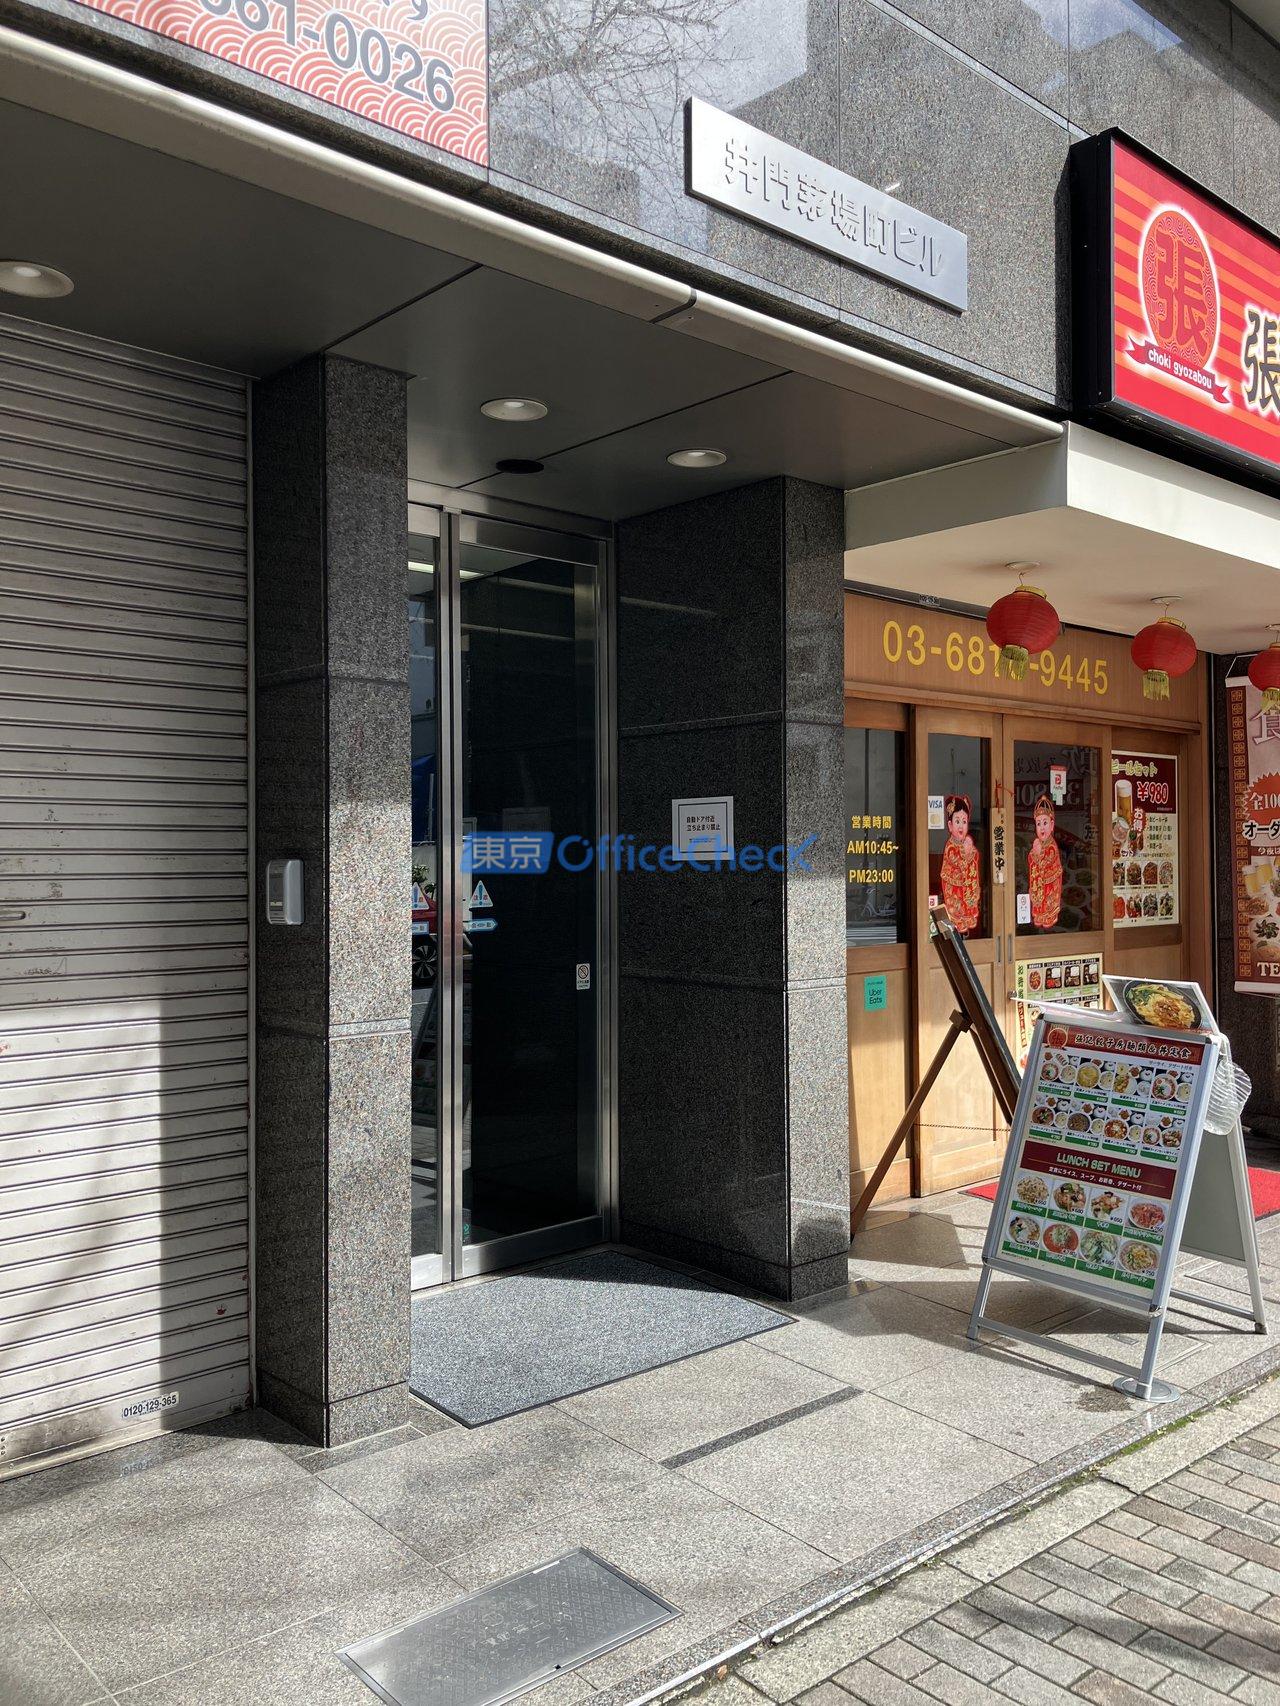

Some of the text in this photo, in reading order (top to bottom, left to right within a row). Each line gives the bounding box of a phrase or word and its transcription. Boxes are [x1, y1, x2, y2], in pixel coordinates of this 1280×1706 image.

[1148, 350, 1212, 390] choki gyozabou
[883, 620, 1108, 695] 03-681-9445
[929, 800, 943, 809] VISA
[1137, 781, 1168, 804] ¥980
[852, 816, 891, 829] 営業時間
[993, 826, 1005, 870] 営業中
[849, 870, 894, 883] PM23:00
[1056, 1152, 1142, 1179] LUNCH SET MENU
[123, 1394, 178, 1418] 0120-129-365
